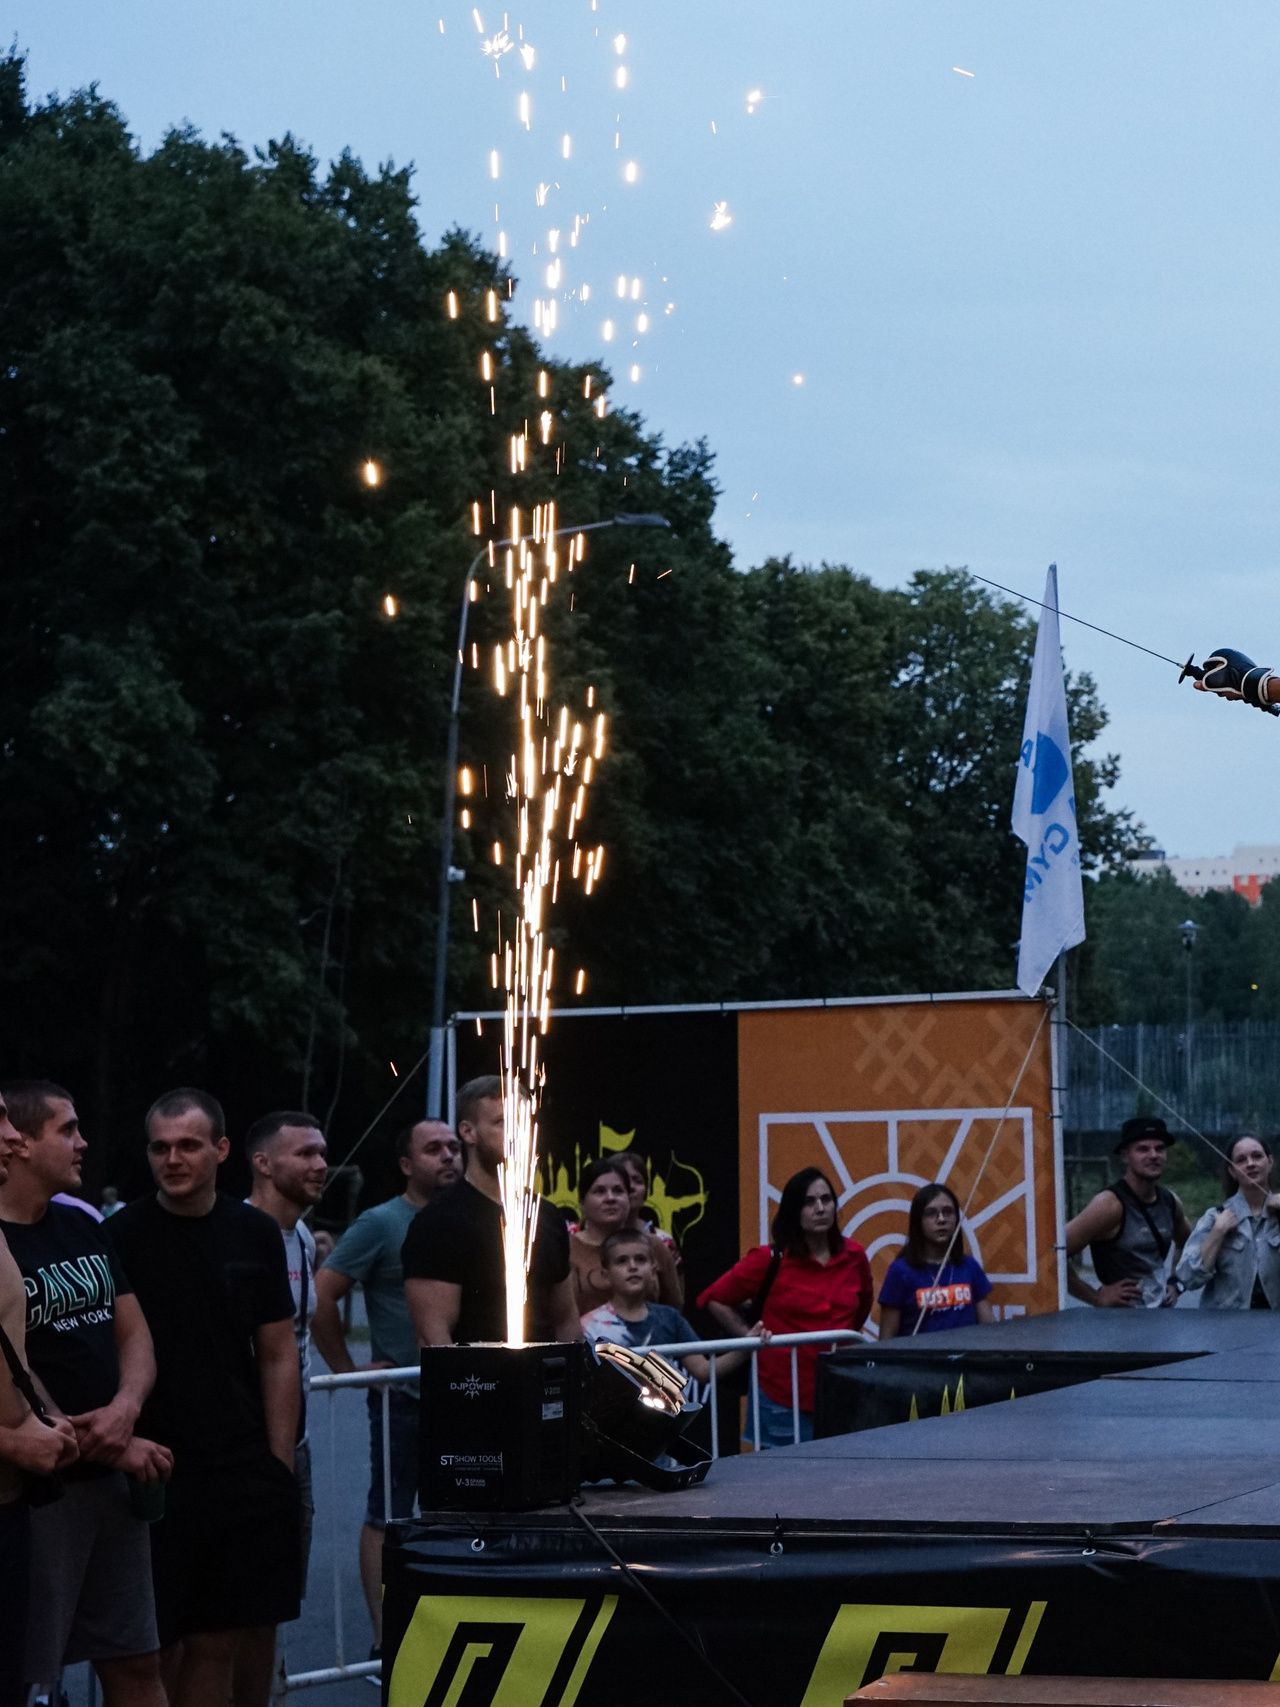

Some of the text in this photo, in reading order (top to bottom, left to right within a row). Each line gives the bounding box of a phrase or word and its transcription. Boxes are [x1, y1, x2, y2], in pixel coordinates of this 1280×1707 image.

[920, 1286, 971, 1306] JUST GO
[52, 1308, 113, 1332] NEW YORK
[440, 1455, 502, 1466] ST SHOW TOOLS
[455, 1478, 470, 1486] V-3
